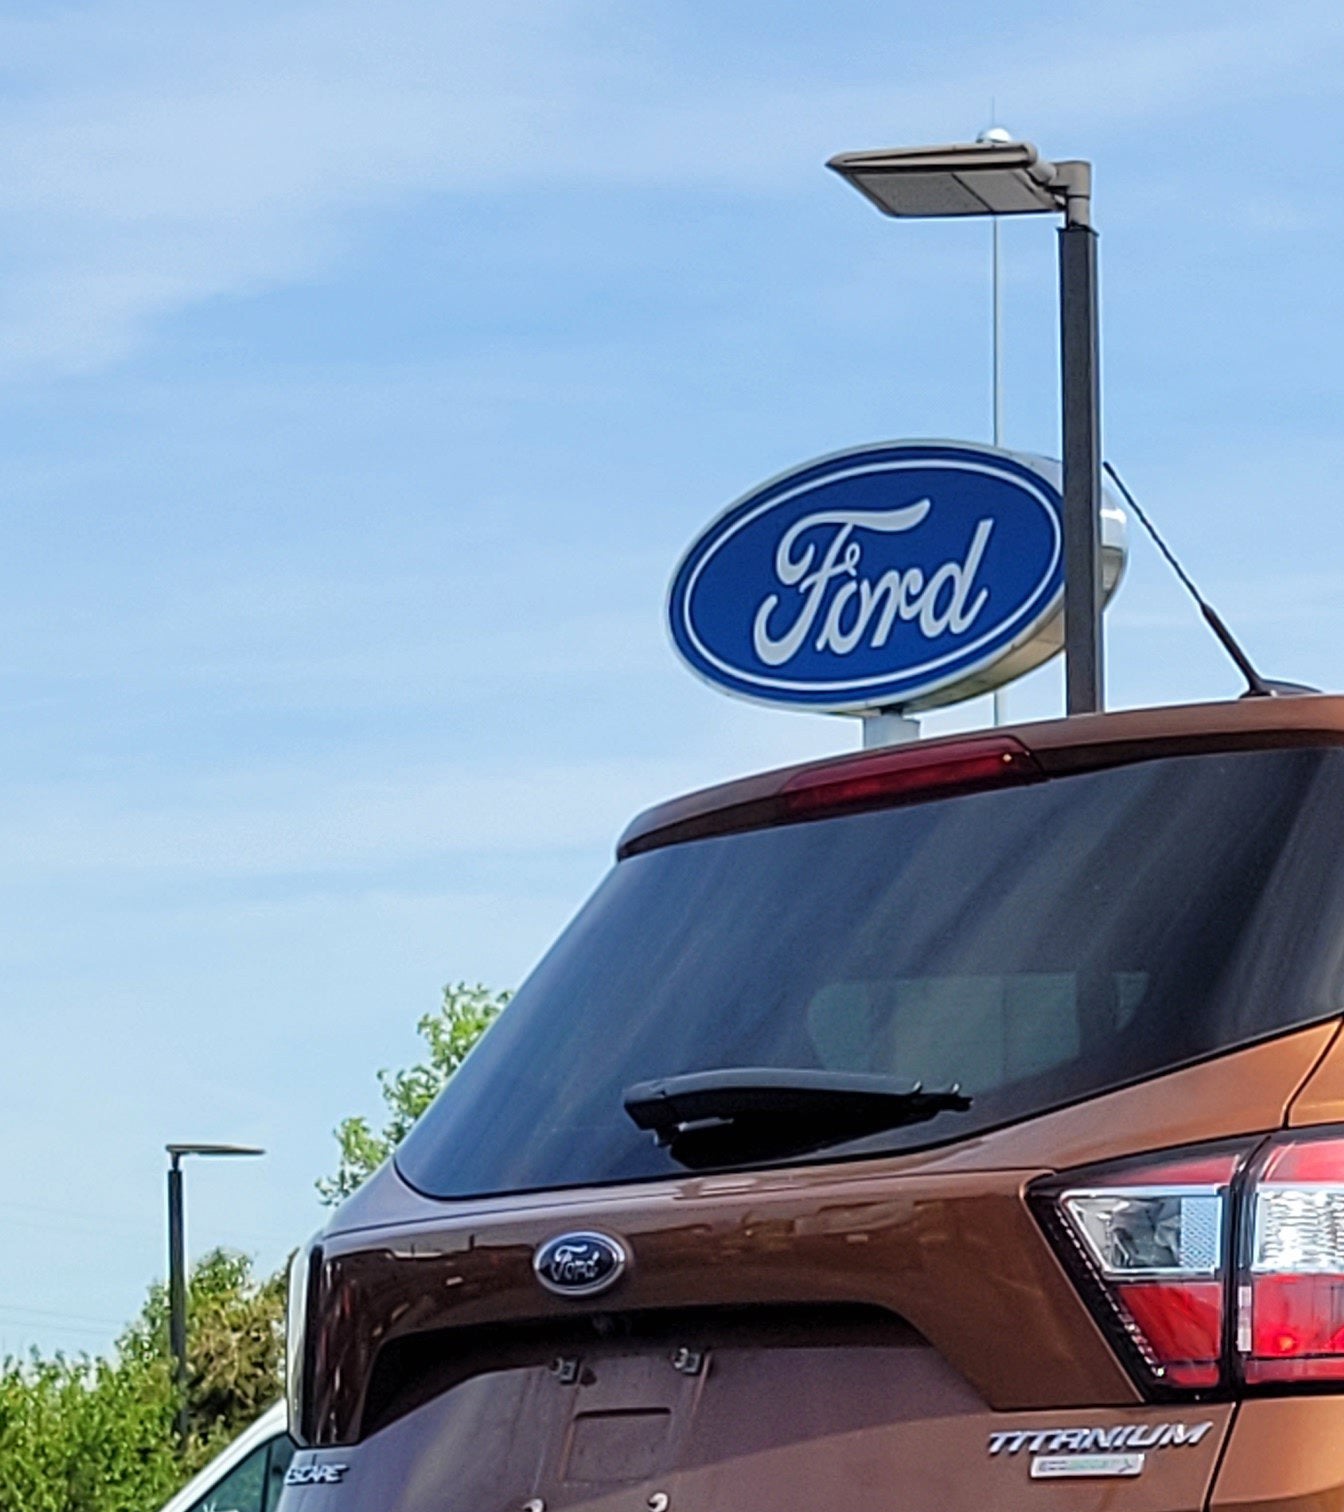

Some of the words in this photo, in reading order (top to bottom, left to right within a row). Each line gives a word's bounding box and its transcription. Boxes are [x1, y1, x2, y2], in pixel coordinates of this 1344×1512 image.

[754, 498, 994, 665] Ford
[551, 1244, 600, 1281] Ford
[988, 1421, 1214, 1453] TITANIUM
